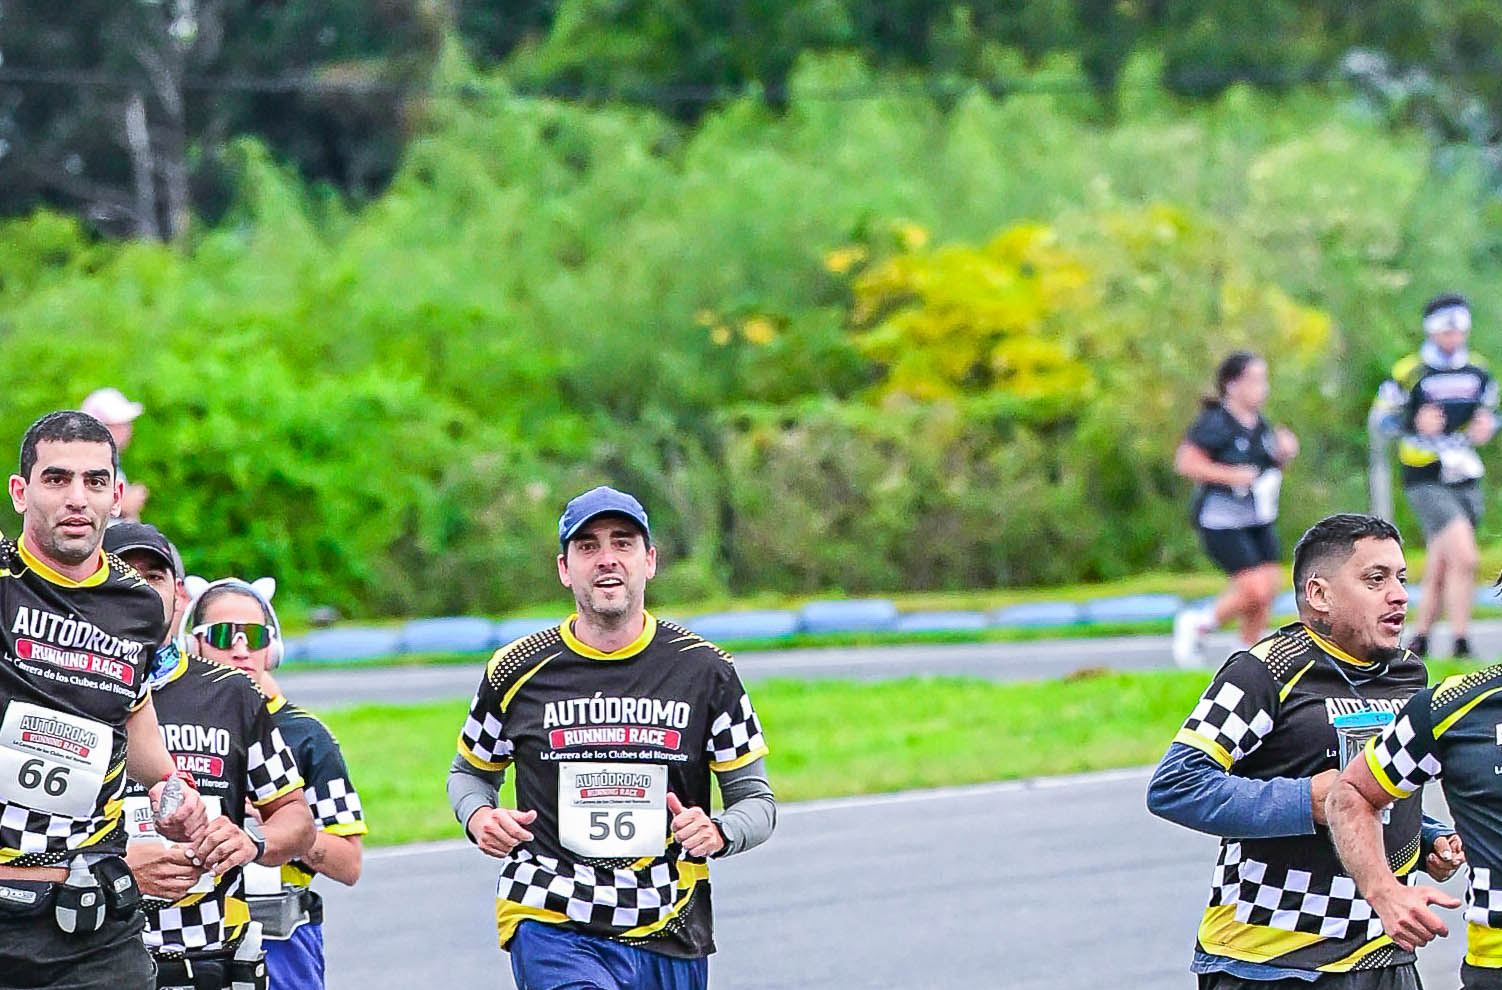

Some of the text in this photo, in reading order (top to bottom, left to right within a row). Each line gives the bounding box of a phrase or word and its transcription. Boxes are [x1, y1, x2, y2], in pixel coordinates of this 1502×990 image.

[31, 643, 124, 680] RUNNING RACE
[44, 669, 55, 680] de
[56, 672, 69, 683] los
[70, 676, 98, 689] Clubes
[99, 681, 112, 691] del
[543, 691, 691, 729] AUTÓDROMO
[20, 714, 98, 749] AUTÓDROMO
[564, 728, 667, 746] RUNNING RACE
[176, 755, 211, 773] RACE
[540, 751, 549, 760] La
[550, 750, 580, 760] Carrera
[582, 750, 593, 759] de
[594, 750, 607, 759] los
[608, 750, 637, 760] Clubes
[639, 750, 652, 759] del
[18, 759, 71, 796] 66
[576, 769, 651, 788] AUTÓDROMO
[589, 811, 636, 841] 56
